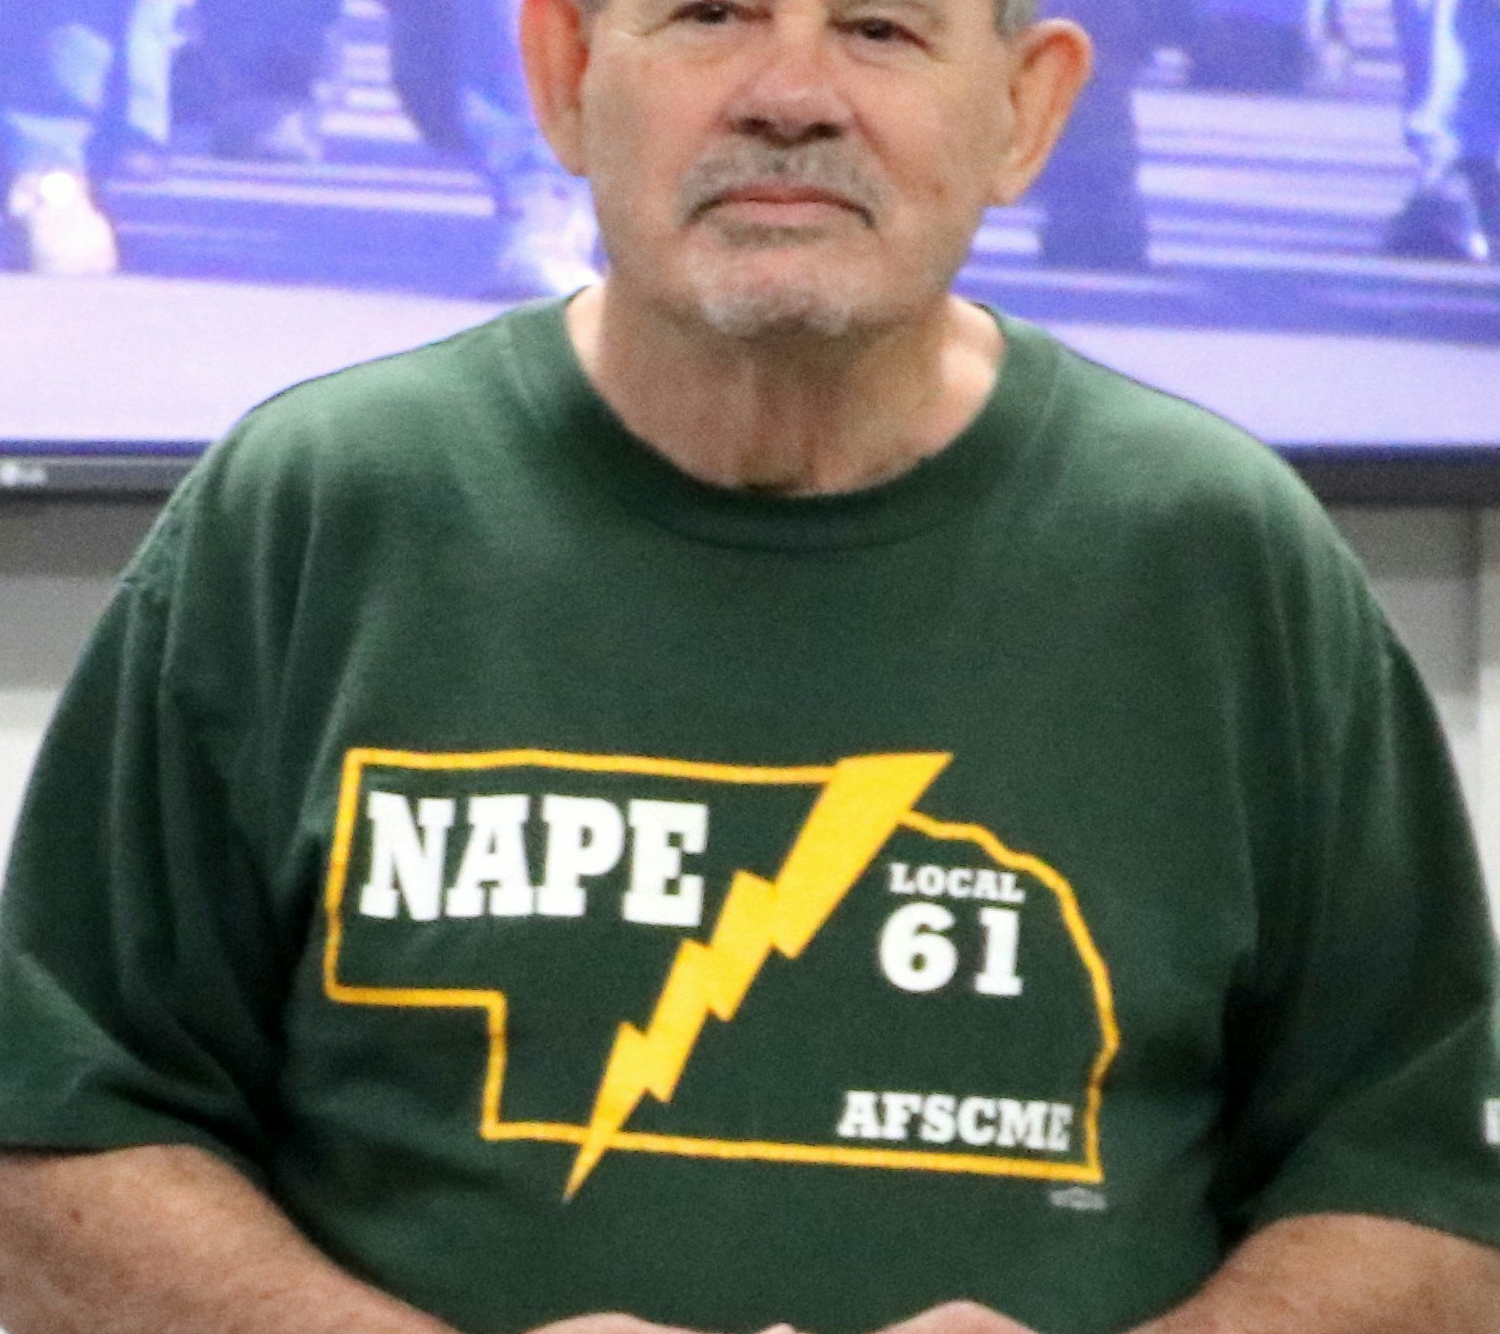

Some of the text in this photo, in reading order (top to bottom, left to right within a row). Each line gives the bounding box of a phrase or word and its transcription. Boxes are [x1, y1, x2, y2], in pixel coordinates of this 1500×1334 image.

[359, 791, 708, 927] NAPE
[889, 862, 1025, 904] LOCAL
[878, 903, 1023, 996] 61
[837, 1090, 1073, 1151] AFSCME
